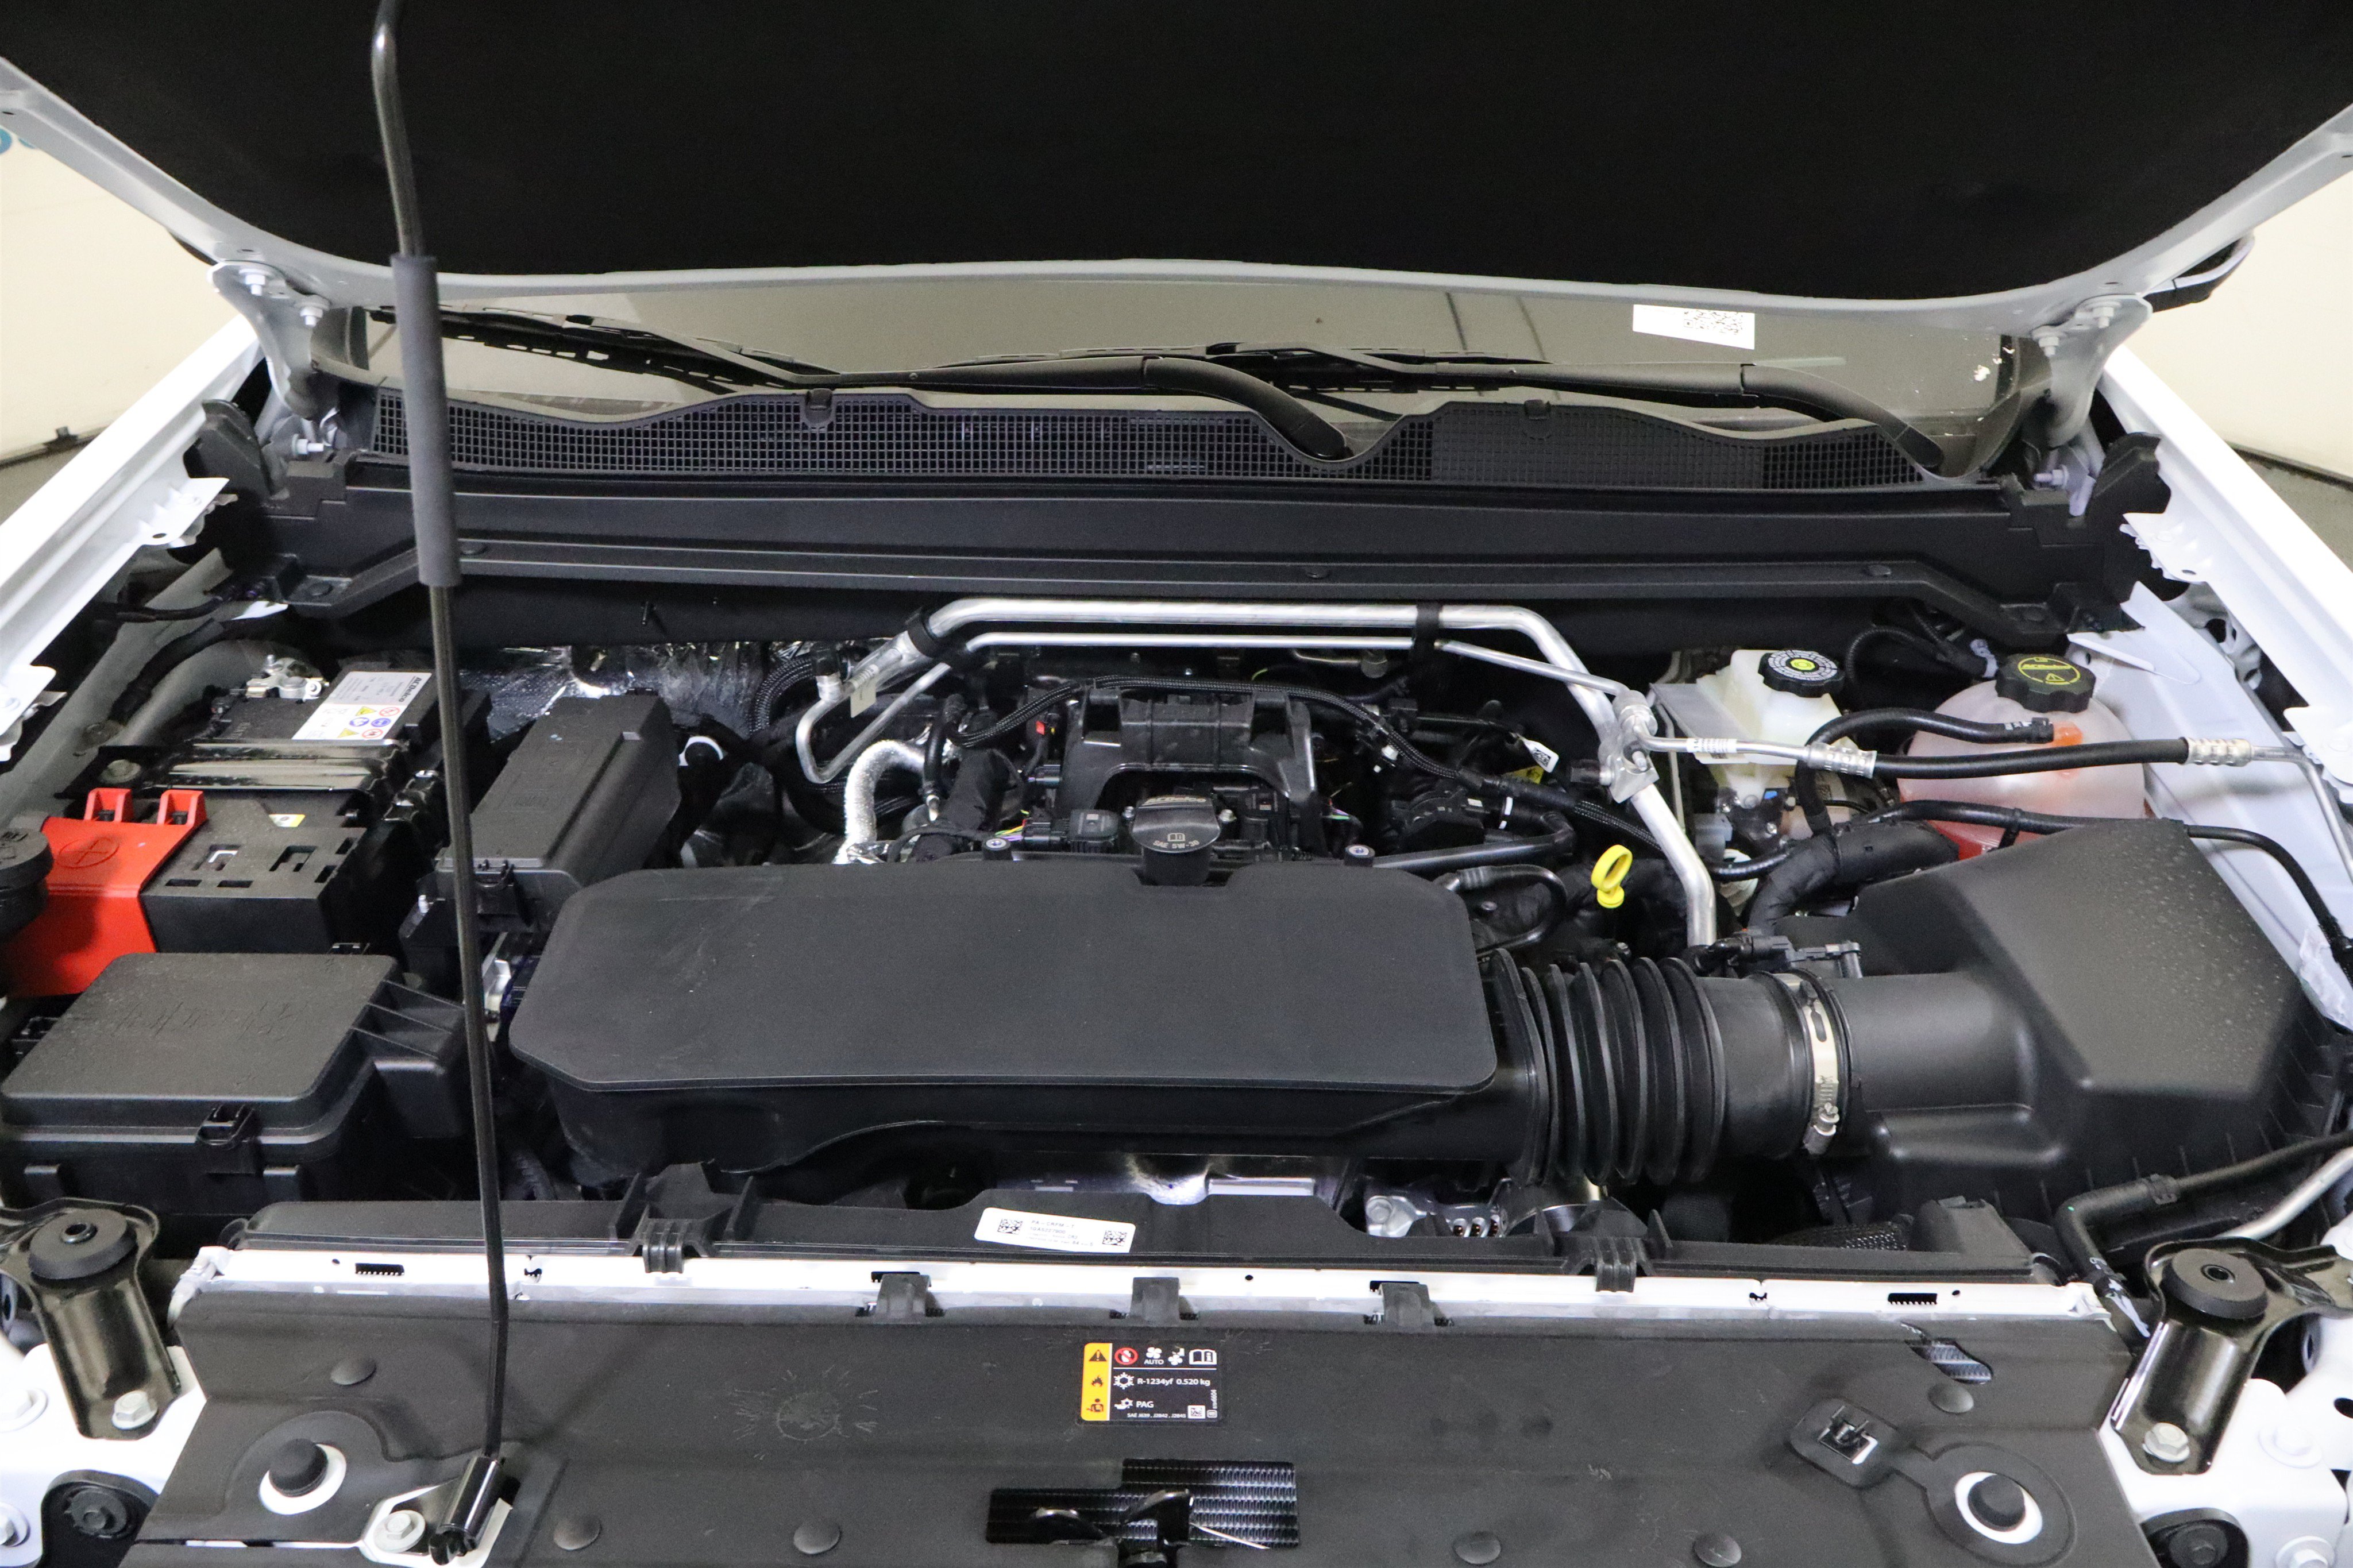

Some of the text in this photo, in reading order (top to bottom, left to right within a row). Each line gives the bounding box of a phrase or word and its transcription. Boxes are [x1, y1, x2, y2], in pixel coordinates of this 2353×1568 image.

[399, 677, 422, 702] ACDelco
[1152, 840, 1199, 849] SAE 5W-30
[1137, 1378, 1174, 1386] R-1234yf
[1200, 1378, 1210, 1387] kg
